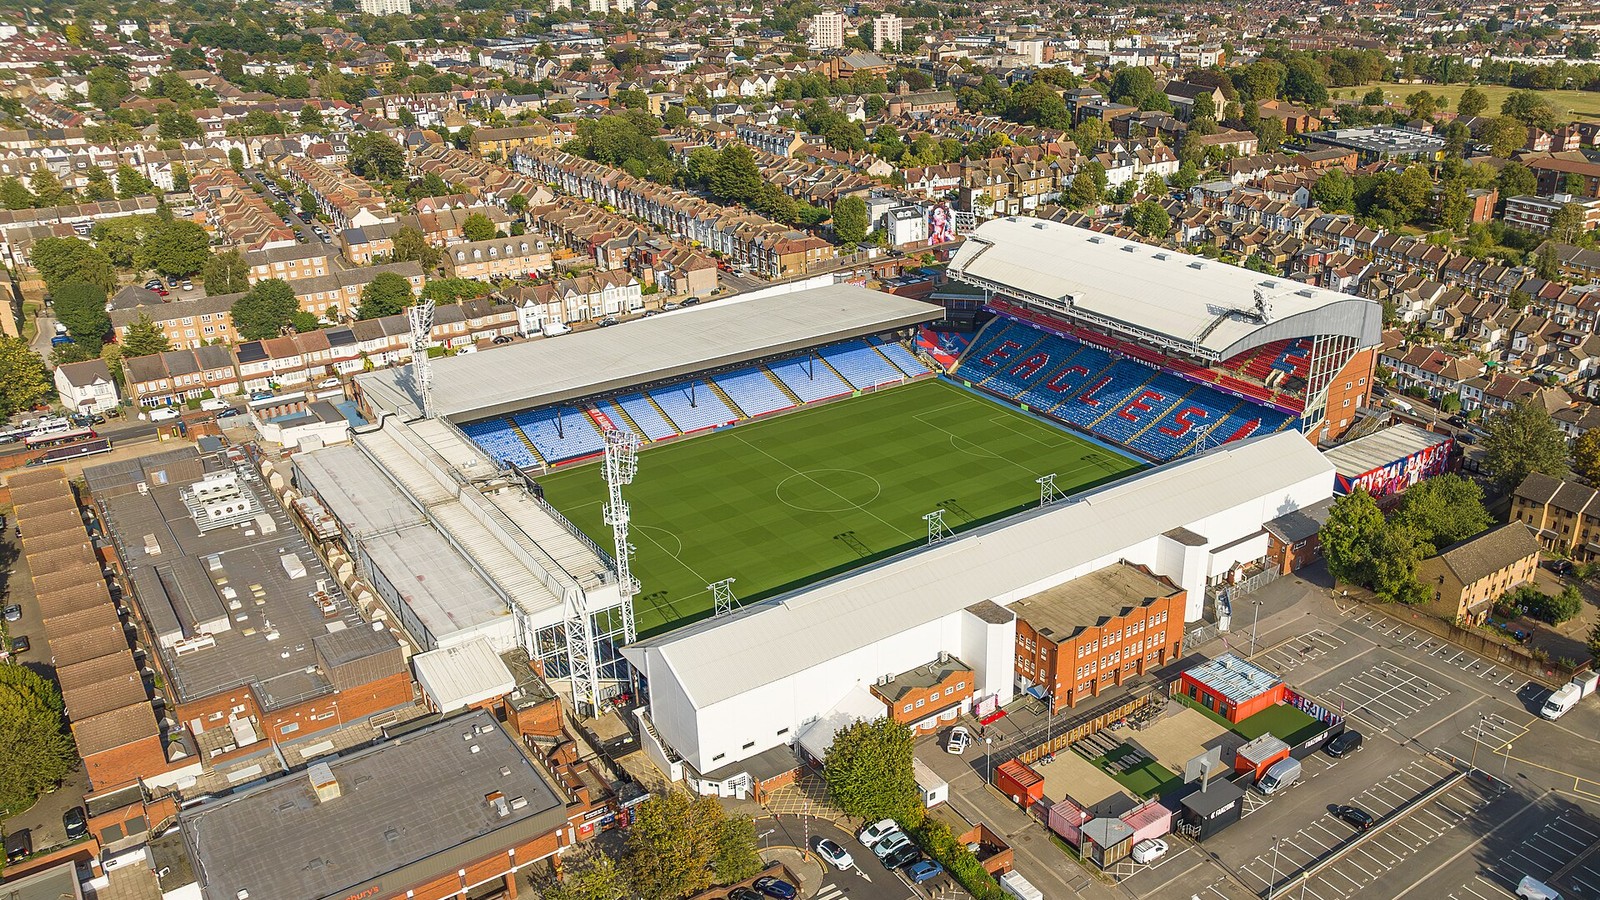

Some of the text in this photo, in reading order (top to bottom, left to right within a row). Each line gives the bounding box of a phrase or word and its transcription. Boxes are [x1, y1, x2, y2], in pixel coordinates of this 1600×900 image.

[980, 339, 1208, 438] EAGLES
[1352, 442, 1451, 492] CRYSTAL PALACE
